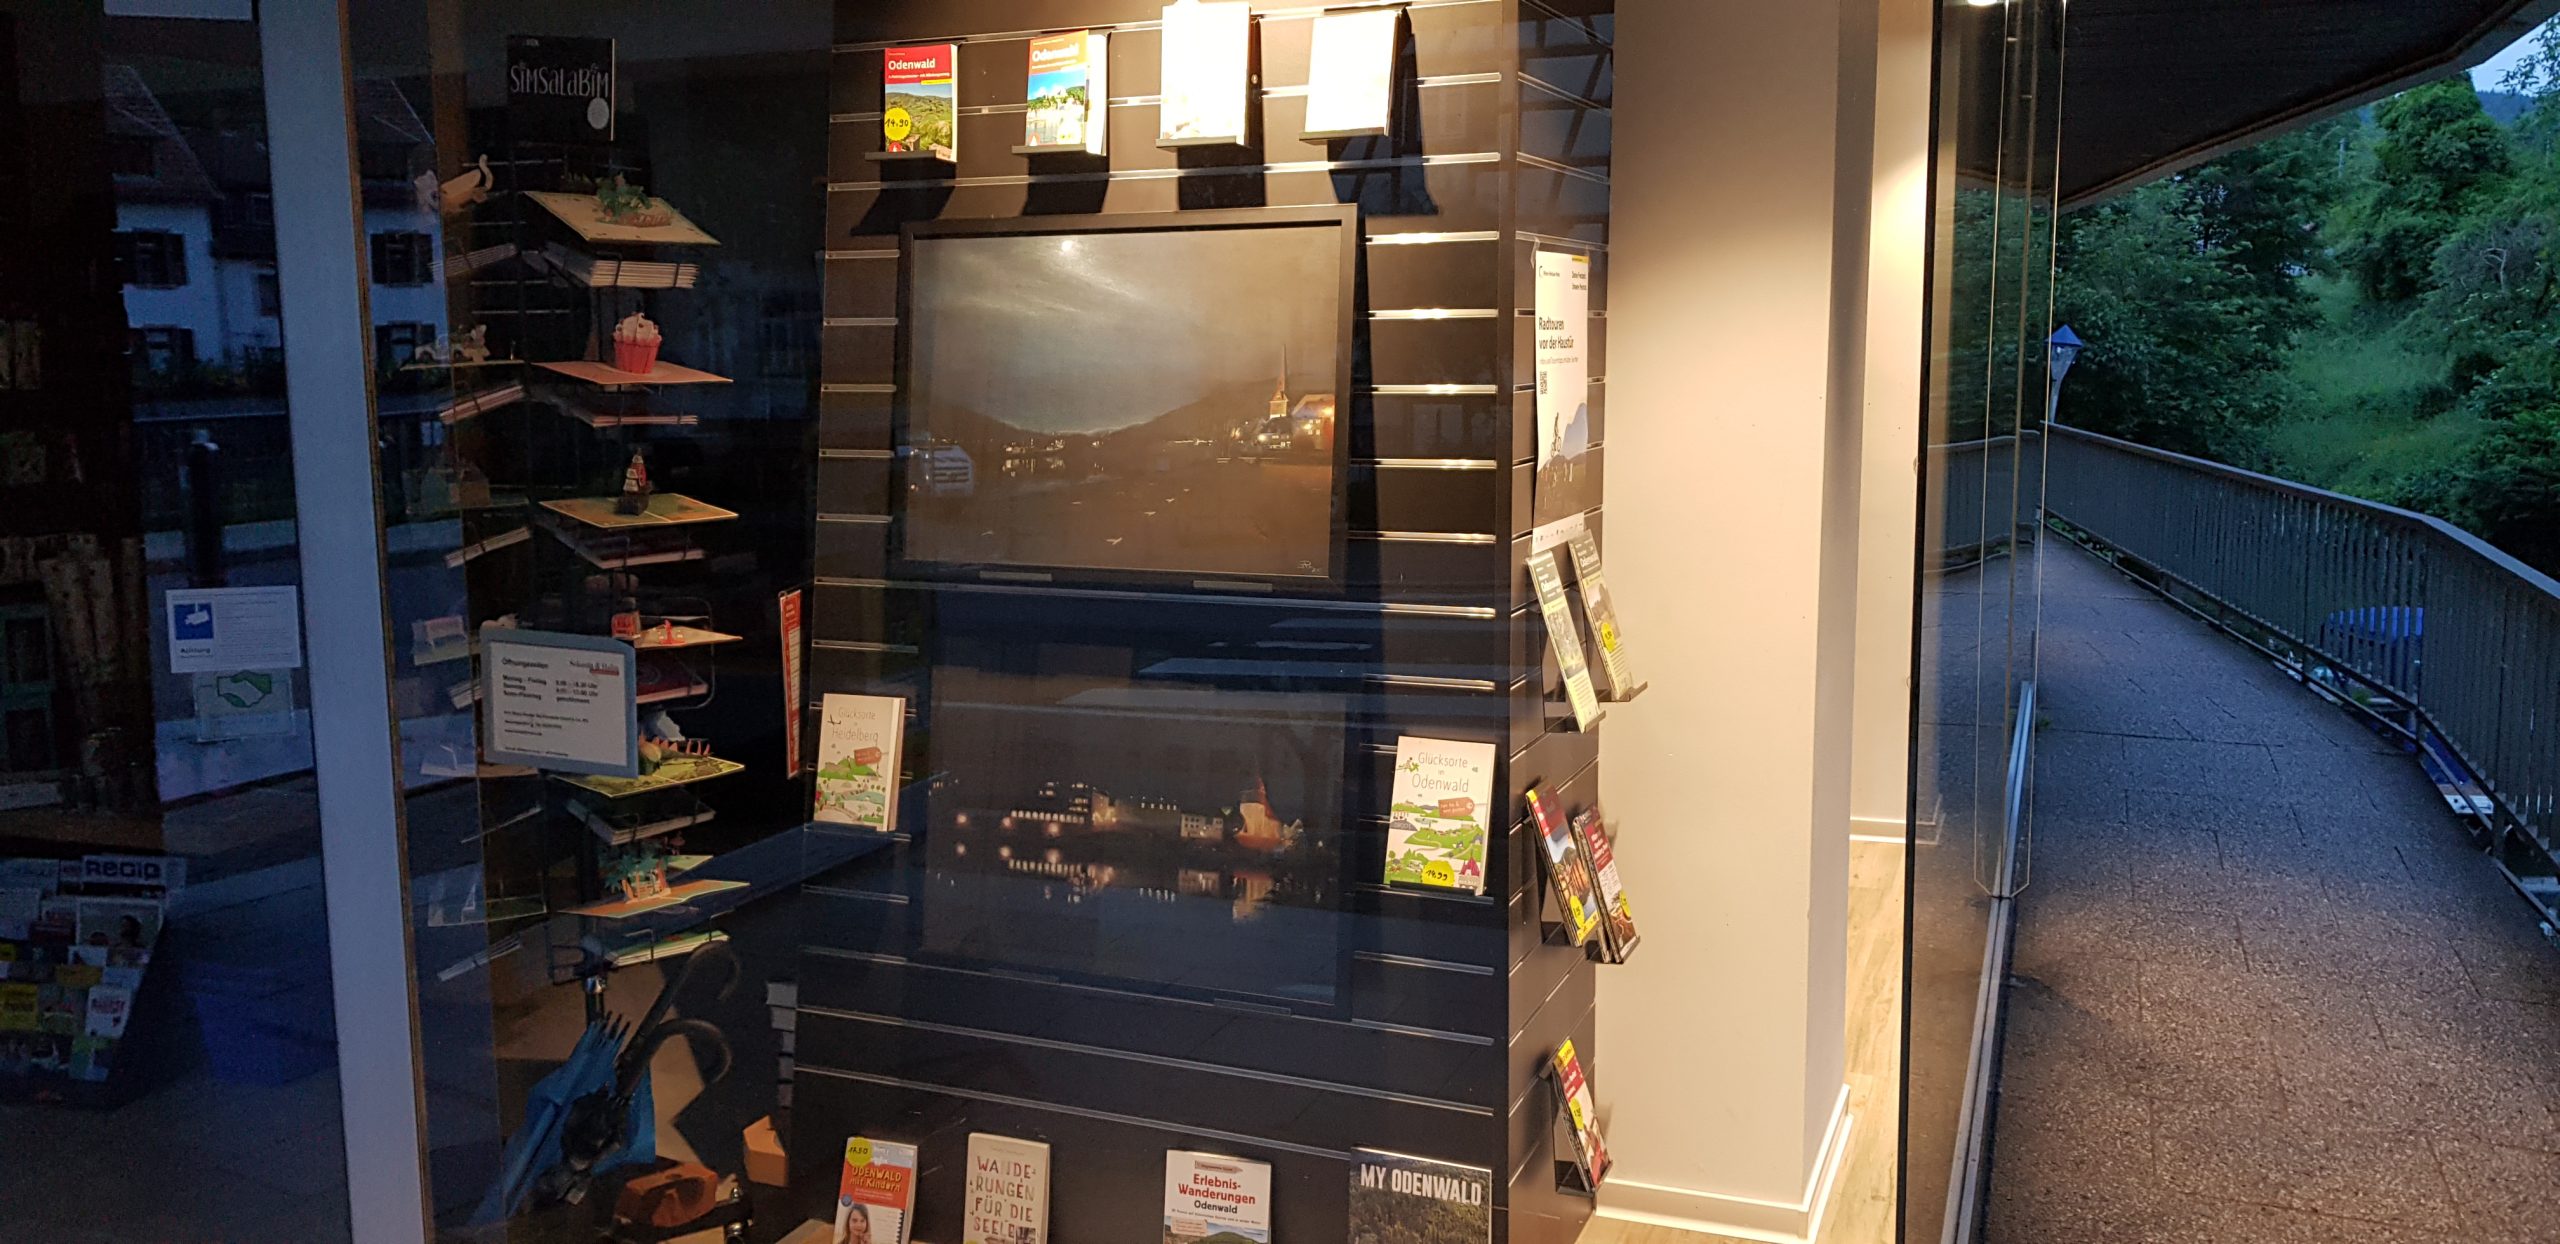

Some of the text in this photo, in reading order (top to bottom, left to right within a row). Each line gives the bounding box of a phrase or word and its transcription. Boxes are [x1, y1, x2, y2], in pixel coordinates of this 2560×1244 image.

[888, 58, 936, 70] Odenwald
[1539, 316, 1564, 330] Radtouren
[1539, 335, 1574, 349] vor der Haustür
[832, 727, 879, 743] Heidelberg
[1418, 752, 1468, 768] Glücksorte
[1411, 774, 1469, 793] Odenwald
[852, 1167, 902, 1182] ODENWALD
[1193, 1173, 1241, 1190] Erlebnis-
[851, 1178, 901, 1192] mit Kindern
[976, 1176, 1034, 1201] RUNGEN
[1360, 1163, 1482, 1206] MY ODENWALD
[1178, 1183, 1256, 1205] Wanderungen
[975, 1195, 1032, 1222] FÜR DIE
[1194, 1200, 1238, 1214] Odenwald
